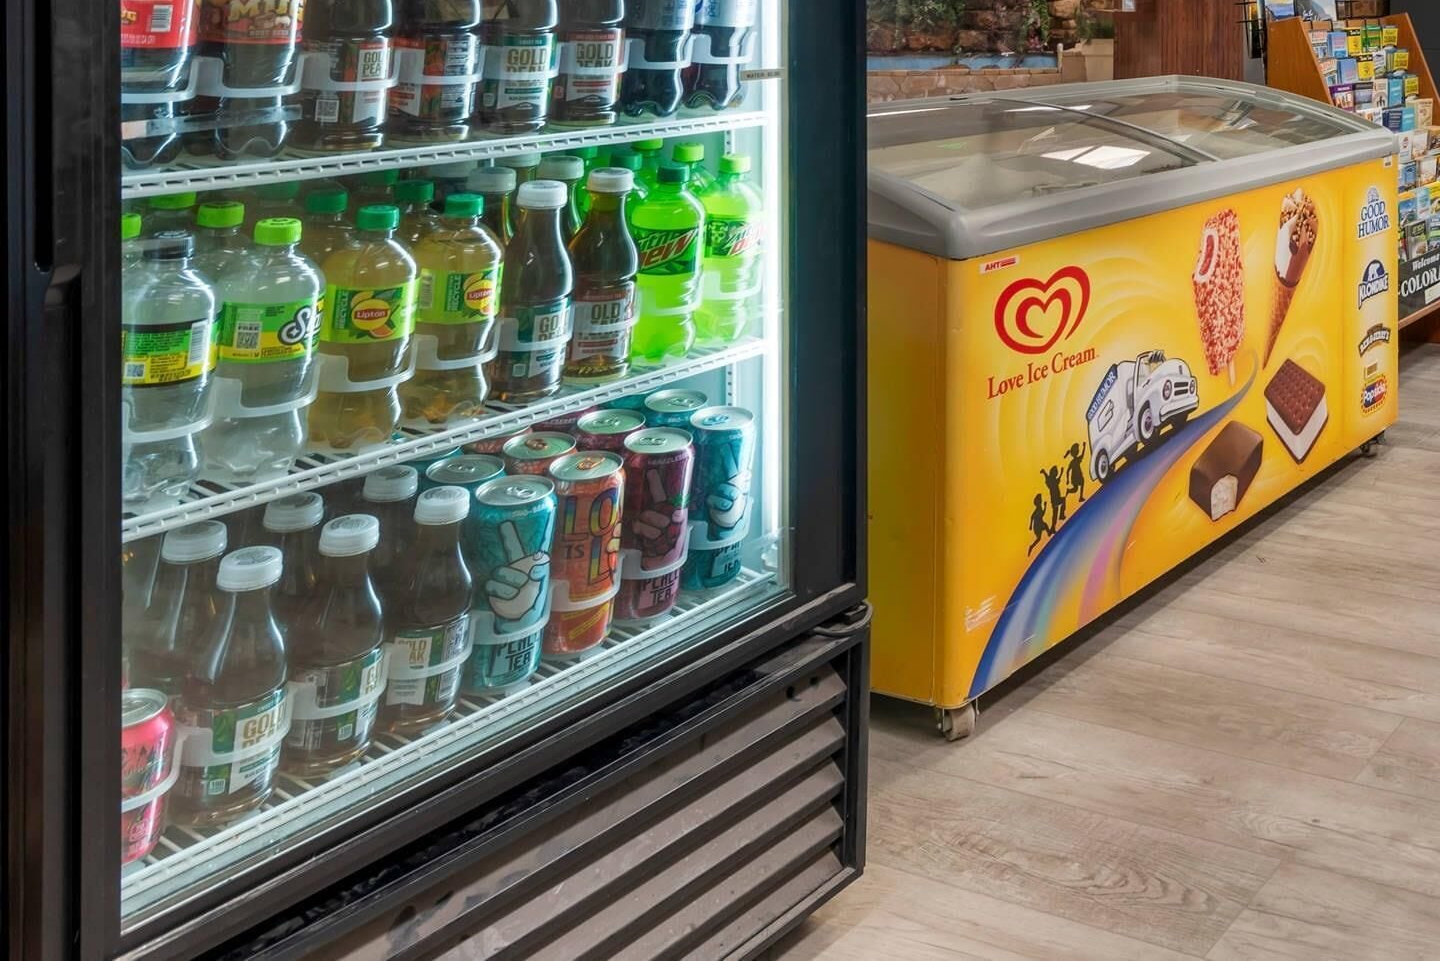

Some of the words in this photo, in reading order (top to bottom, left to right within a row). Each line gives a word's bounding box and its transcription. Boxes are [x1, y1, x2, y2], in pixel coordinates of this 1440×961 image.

[363, 50, 384, 63] GOL
[362, 63, 383, 75] PEA
[1361, 201, 1385, 221] GOOD
[1358, 215, 1390, 238] HUMOR
[984, 261, 1001, 272] AHT
[1412, 253, 1440, 271] Welcome
[356, 310, 386, 319] Lipton
[987, 373, 1025, 400] Love
[1027, 362, 1049, 384] Ice
[1051, 347, 1097, 374] Cream
